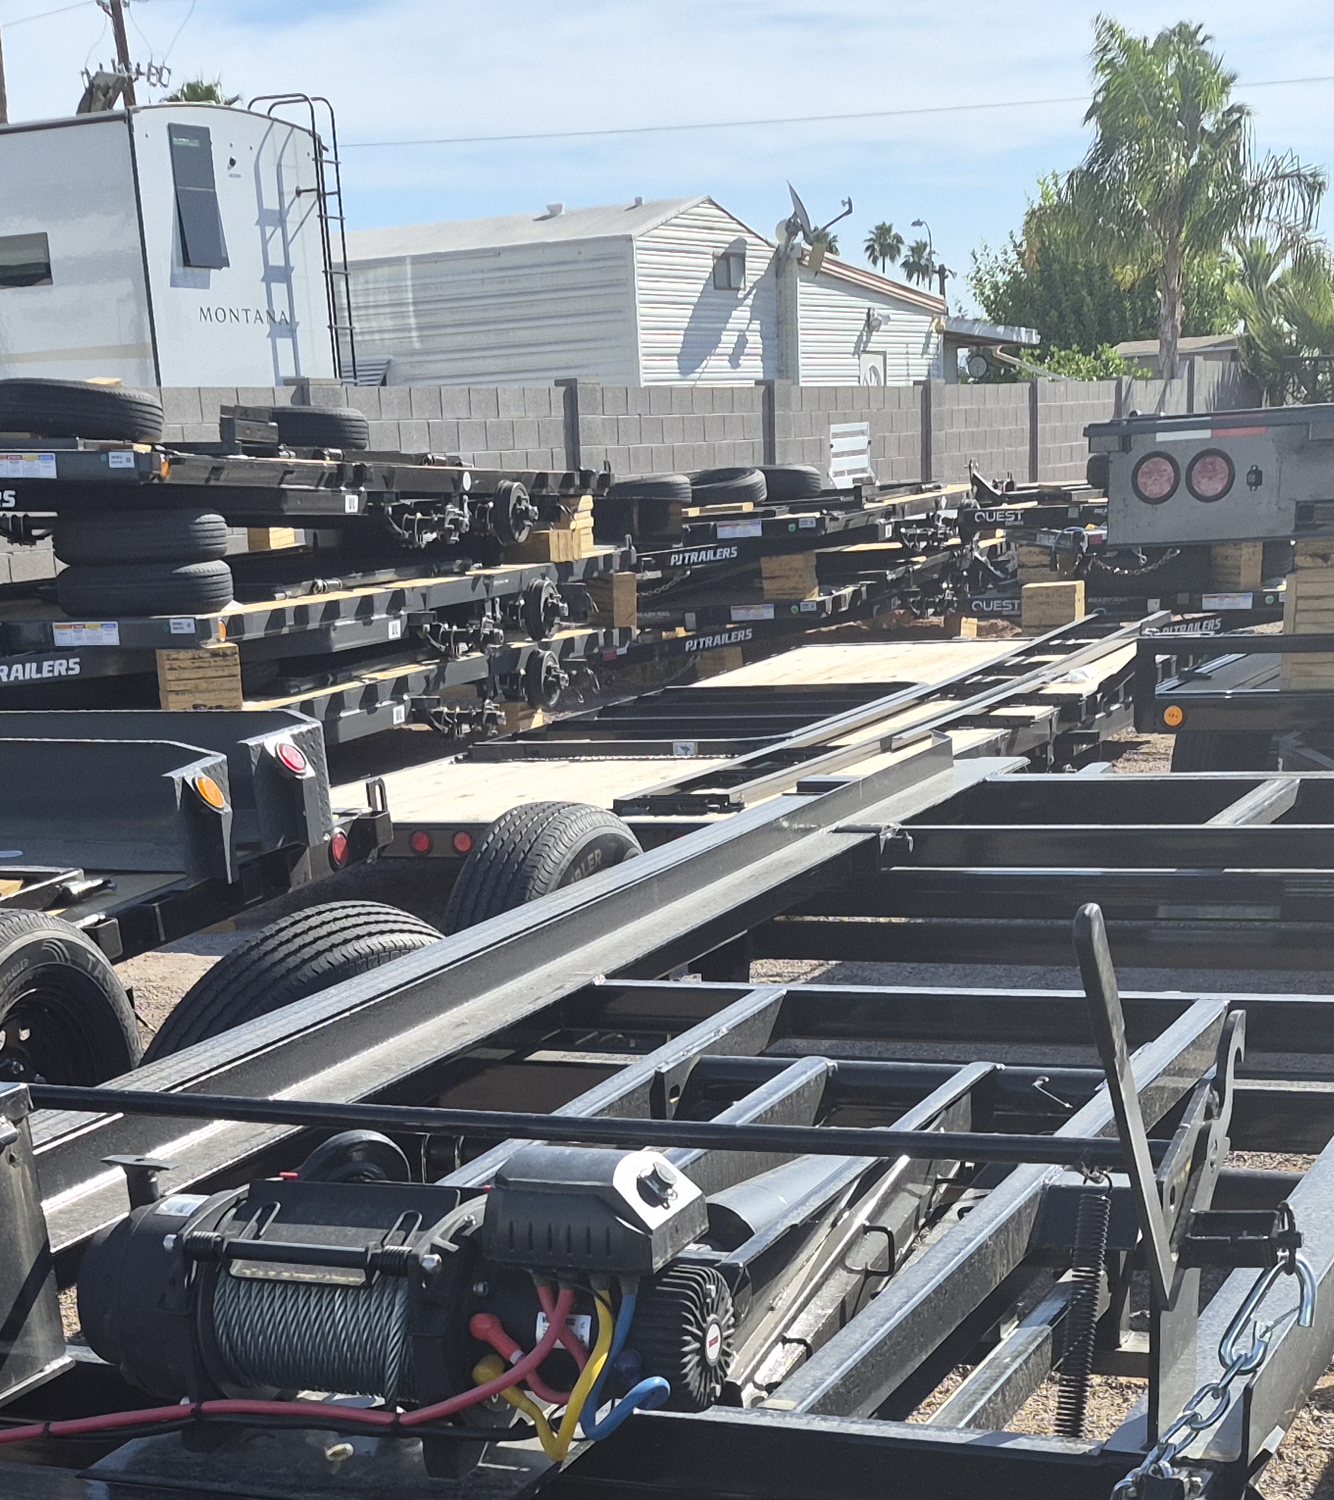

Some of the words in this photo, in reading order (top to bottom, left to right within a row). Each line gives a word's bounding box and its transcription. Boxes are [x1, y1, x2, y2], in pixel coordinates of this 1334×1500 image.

[199, 306, 290, 326] MONTANA
[974, 510, 1024, 523] QUEST
[670, 553, 685, 566] PJ
[684, 547, 738, 564] TRAILERS
[971, 600, 1021, 612] QUEST
[685, 639, 699, 652] PJ
[698, 628, 753, 650] TRAILERS
